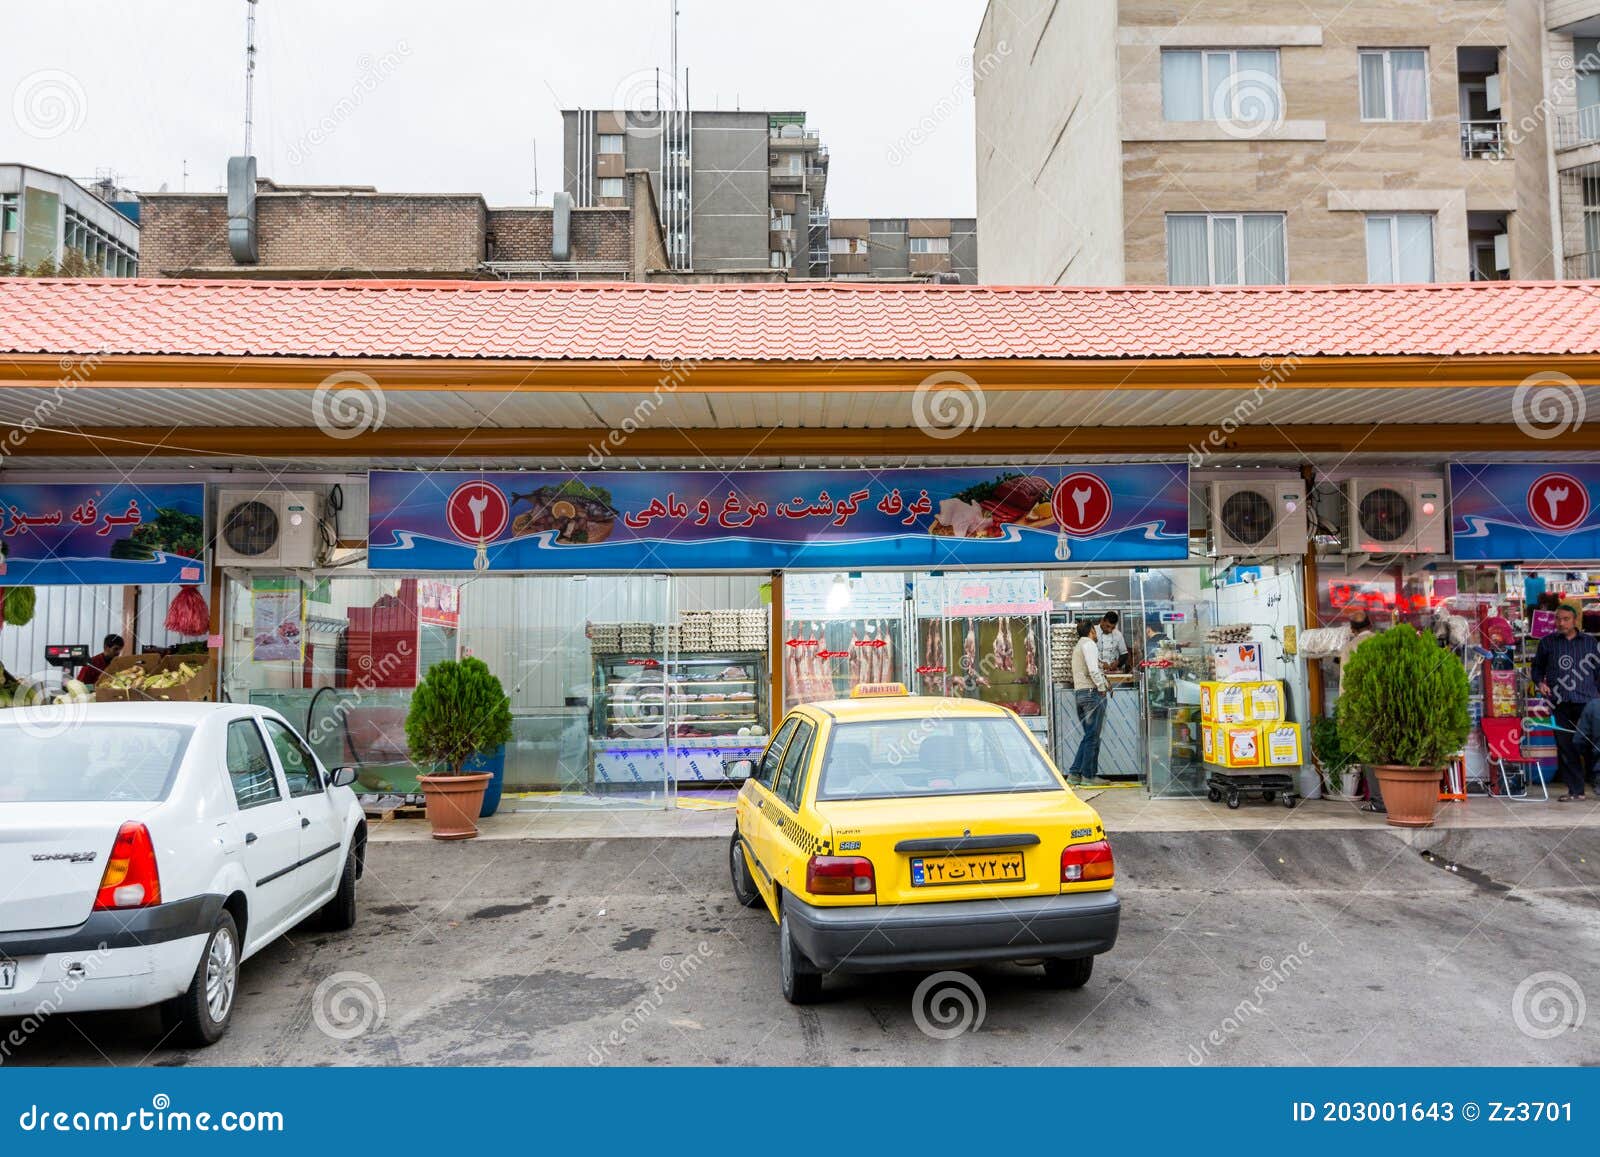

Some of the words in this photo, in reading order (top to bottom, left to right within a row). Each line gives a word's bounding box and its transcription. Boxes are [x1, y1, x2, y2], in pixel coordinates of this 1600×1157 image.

[0, 505, 64, 537] سبز
[71, 499, 142, 537] غرفه
[468, 494, 489, 534] ۲
[624, 492, 689, 529] ماهی
[694, 498, 711, 528] و
[718, 490, 769, 529] مرغ
[775, 489, 870, 527] گوشت،
[877, 488, 933, 526] غرفه
[1071, 485, 1092, 525] ۲
[1543, 485, 1570, 523] ۳
